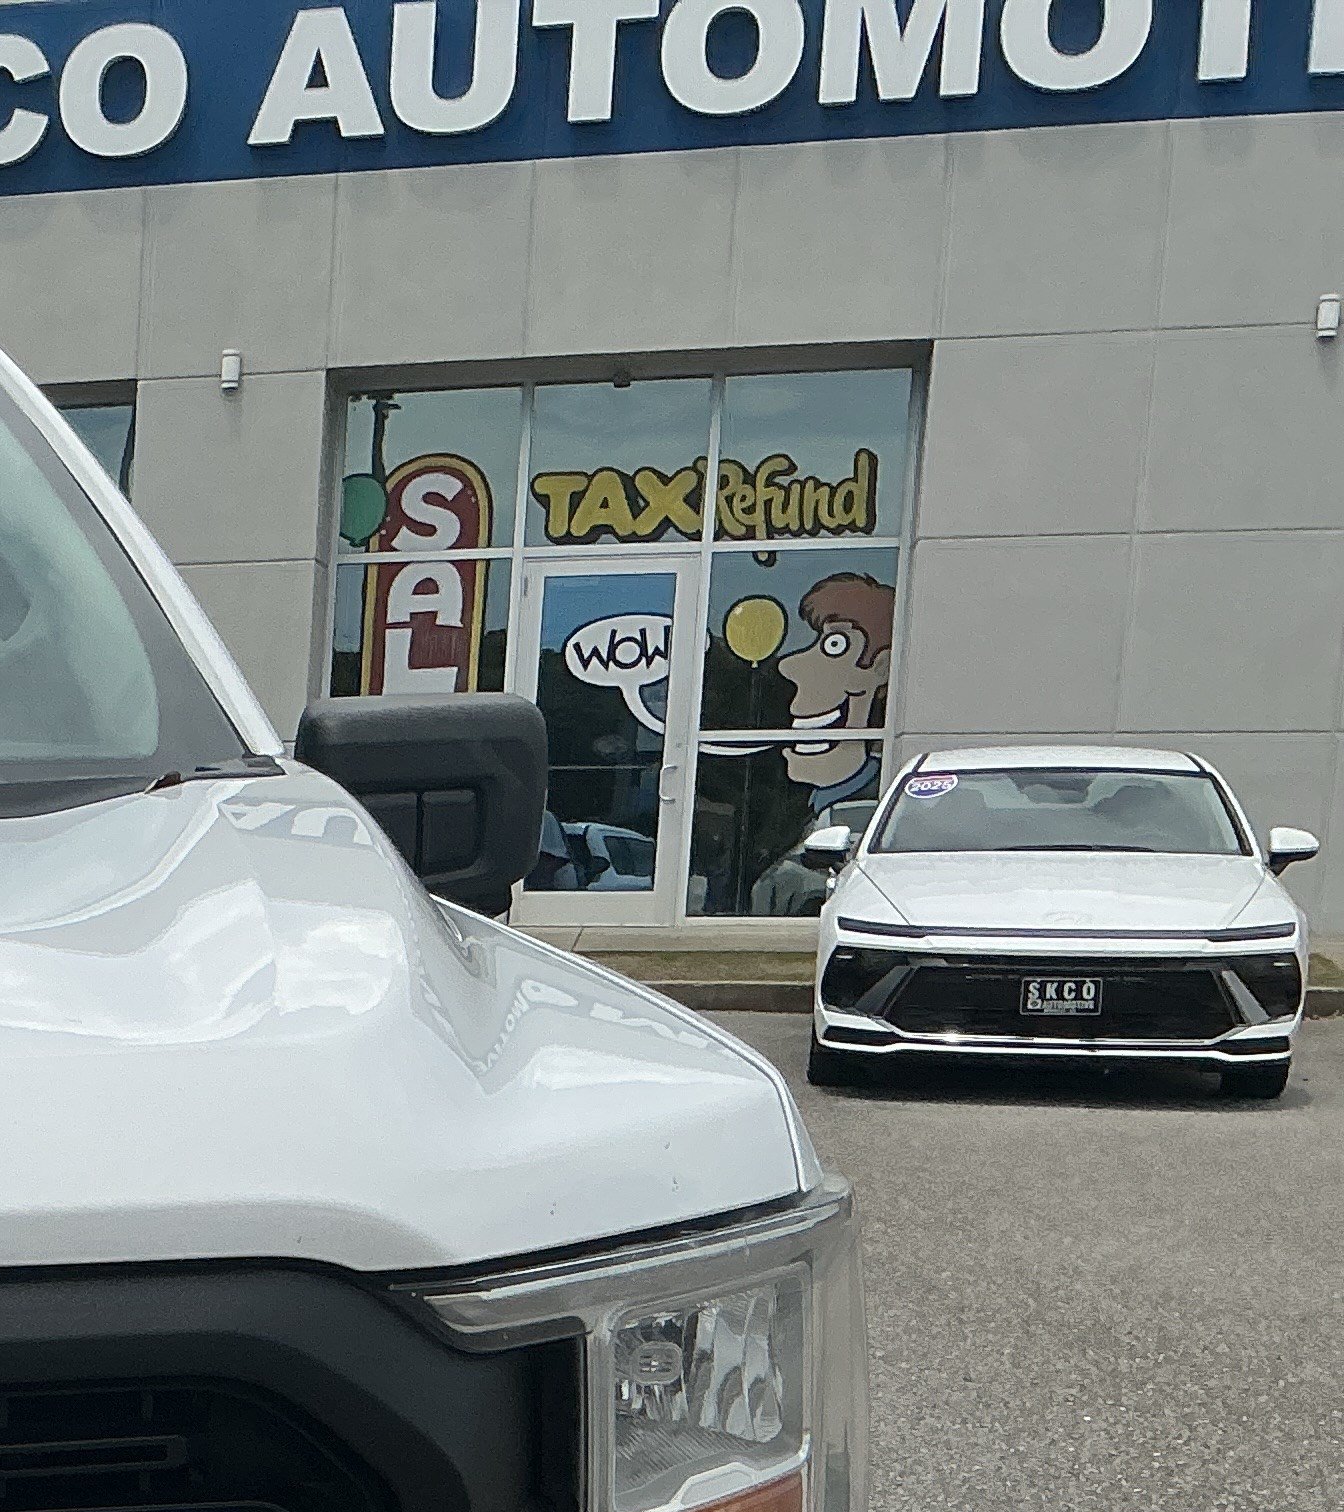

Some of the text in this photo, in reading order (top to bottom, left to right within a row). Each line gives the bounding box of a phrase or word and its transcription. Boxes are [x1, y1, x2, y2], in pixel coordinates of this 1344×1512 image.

[532, 449, 877, 566] TAX Refund
[572, 624, 673, 672] WOW
